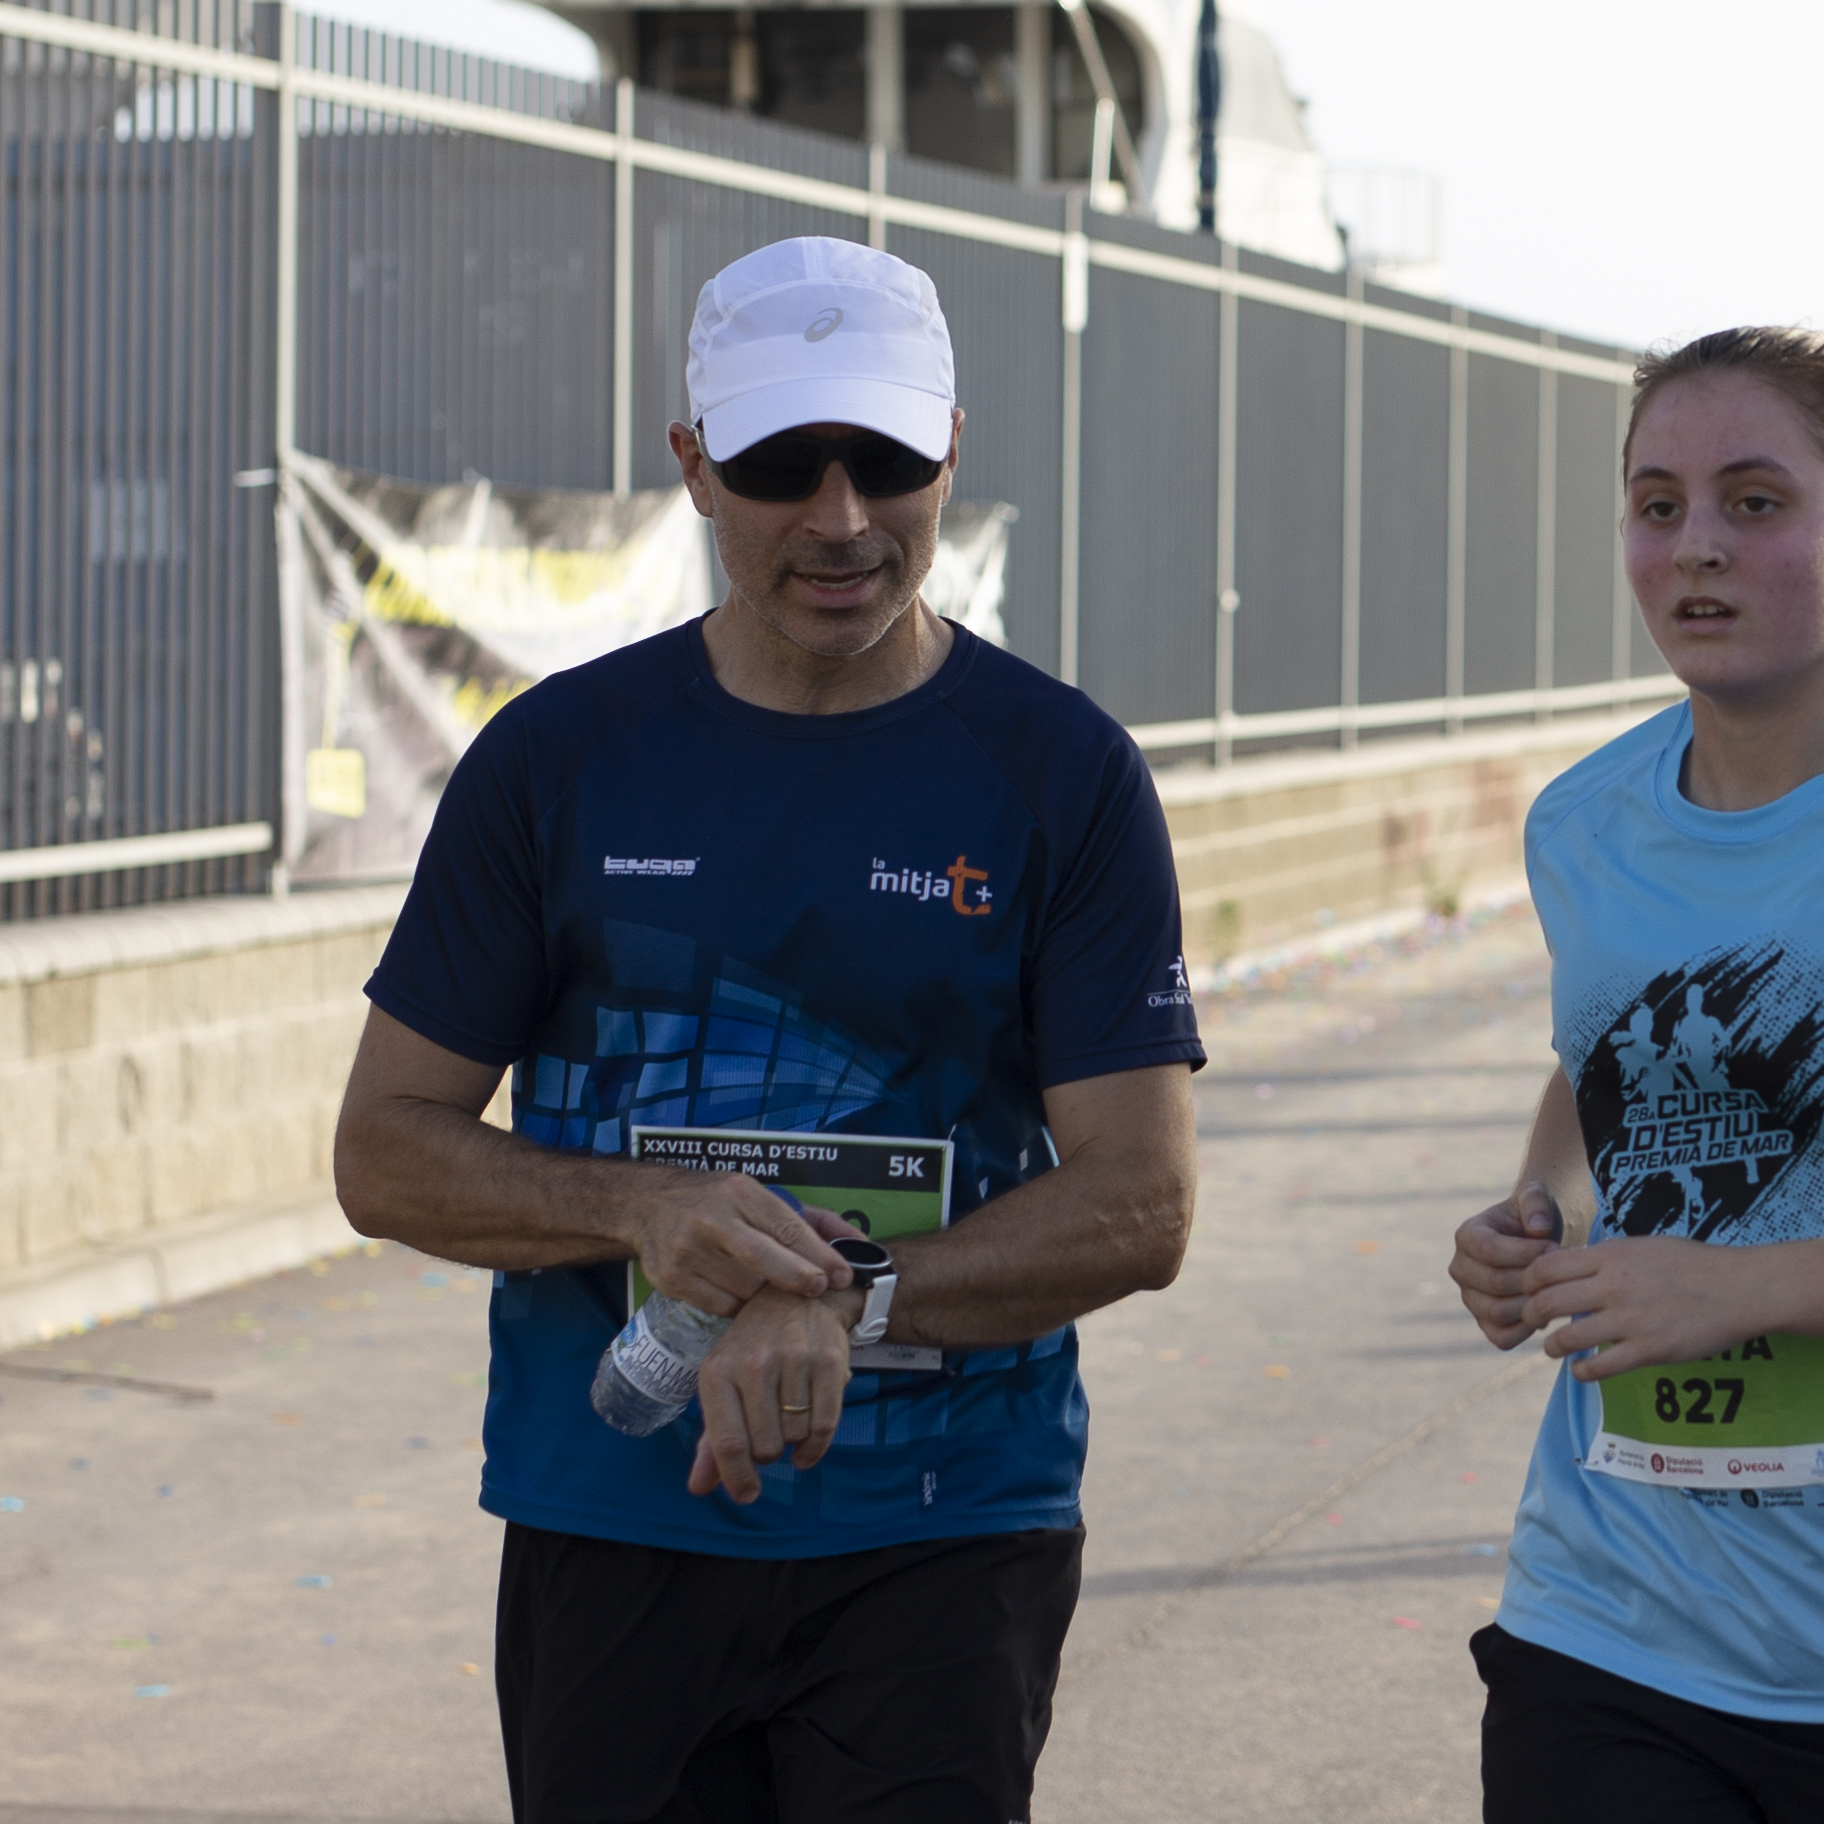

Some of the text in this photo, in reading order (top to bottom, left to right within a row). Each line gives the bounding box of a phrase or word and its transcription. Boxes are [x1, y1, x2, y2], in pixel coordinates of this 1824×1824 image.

[872, 857, 886, 869] la
[1657, 1091, 1767, 1119] CURSA
[644, 1139, 703, 1155] XXVIII
[707, 1142, 764, 1158] CURSA
[1706, 1140, 1738, 1161] DE
[1740, 1133, 1791, 1156] MAR
[742, 1162, 779, 1177] MAR
[888, 1155, 925, 1178] 5K
[1655, 1377, 1745, 1424] 827
[1743, 1462, 1785, 1472] VEOLIA
